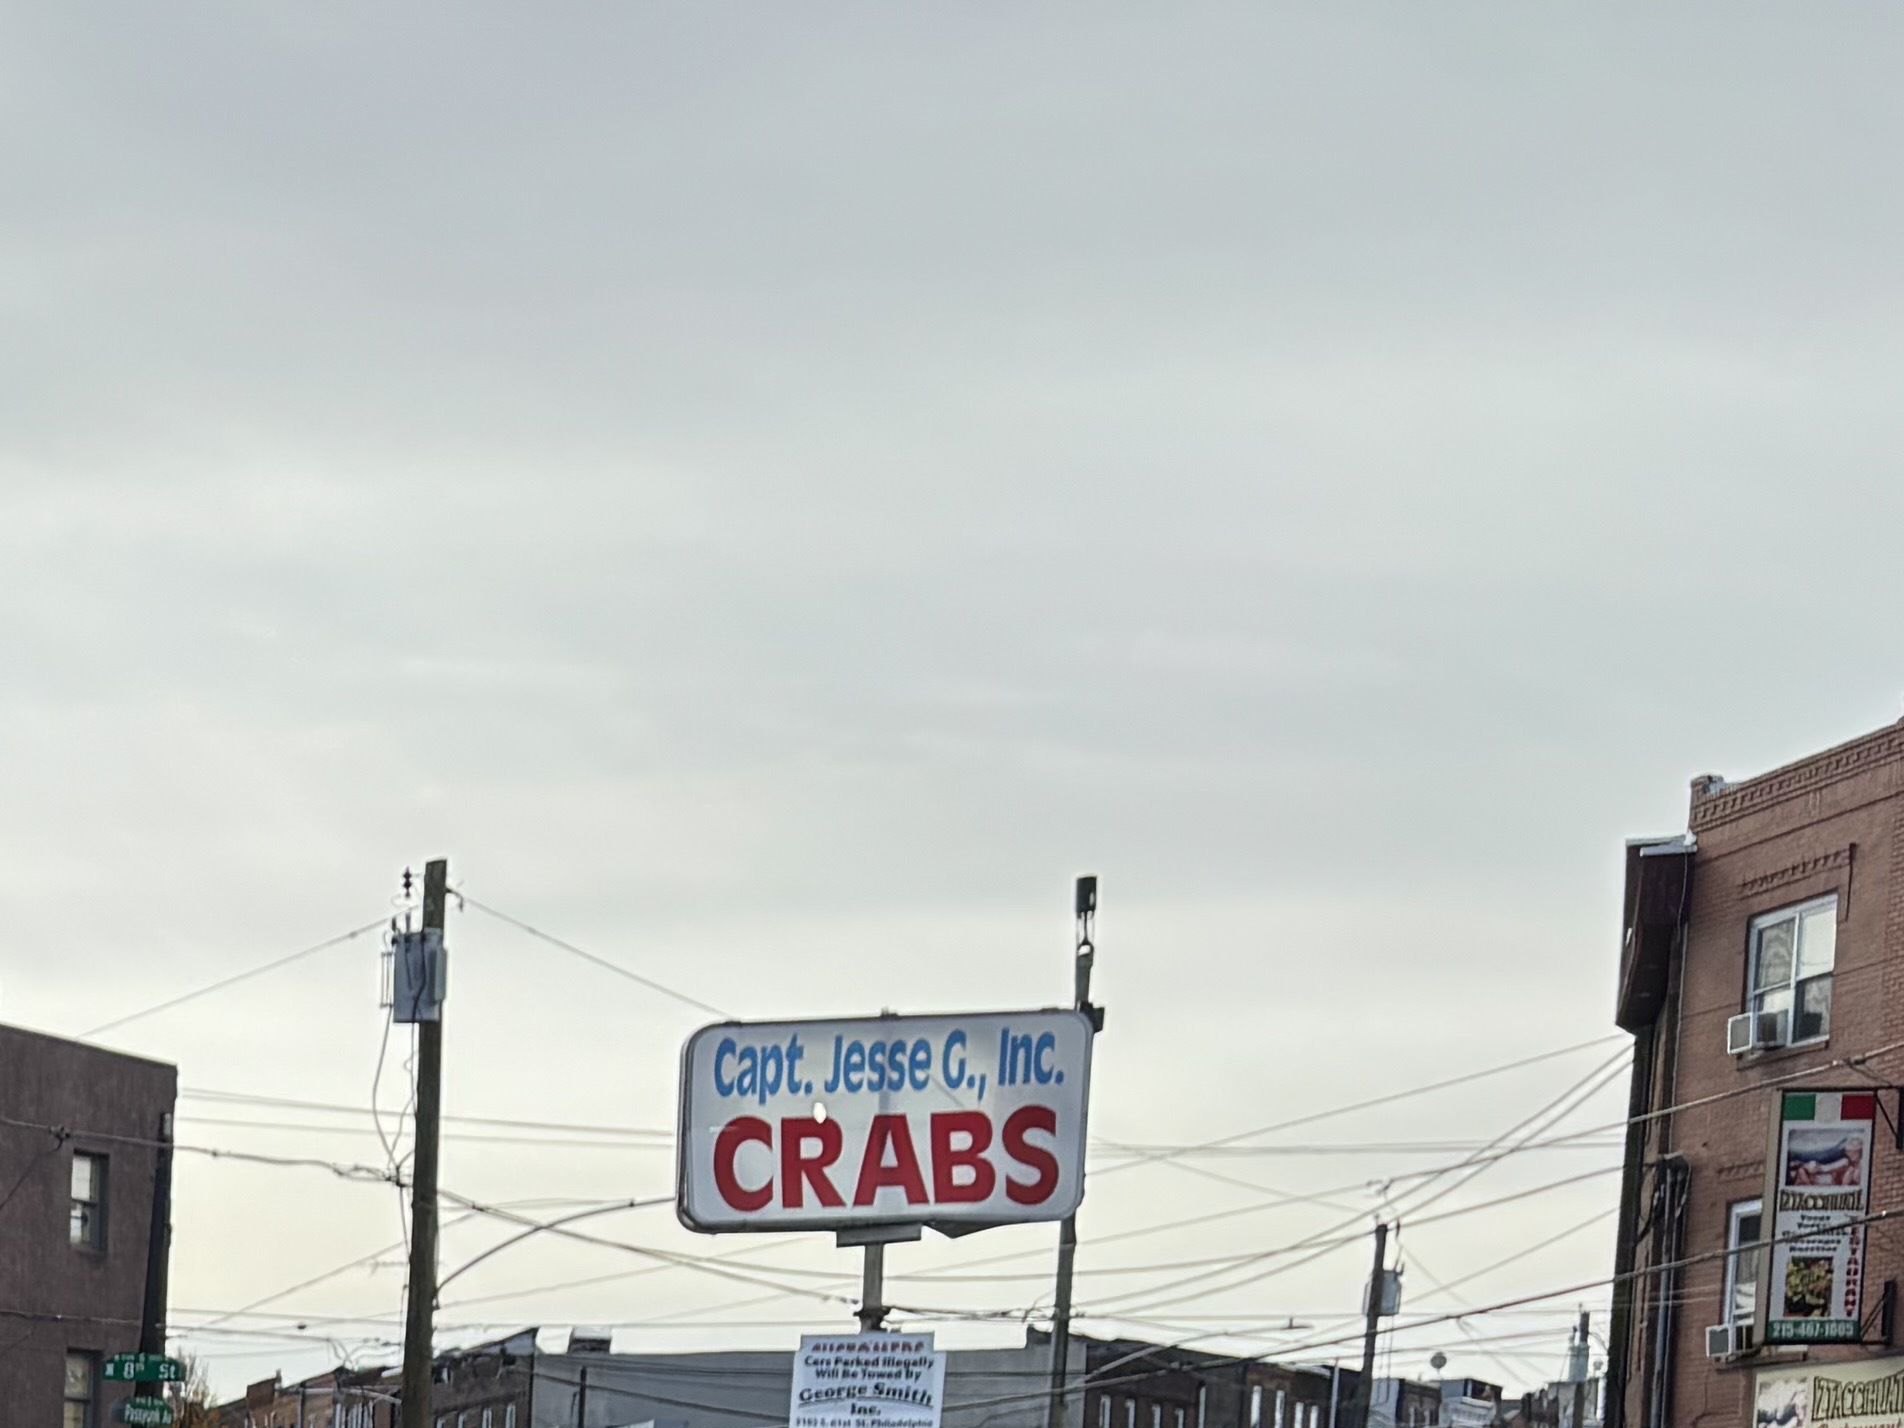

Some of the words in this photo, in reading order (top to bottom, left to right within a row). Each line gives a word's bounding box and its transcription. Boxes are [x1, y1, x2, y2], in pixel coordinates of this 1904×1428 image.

[714, 1033, 813, 1106] Capt.
[825, 1034, 932, 1094] Jesse
[998, 1028, 1064, 1086] Inc.
[713, 1105, 1059, 1212] CRABS
[804, 1355, 831, 1367] Cars
[834, 1355, 879, 1368] Parked
[815, 1368, 839, 1380] Will
[799, 1384, 868, 1404] George
[873, 1382, 934, 1407] Smith
